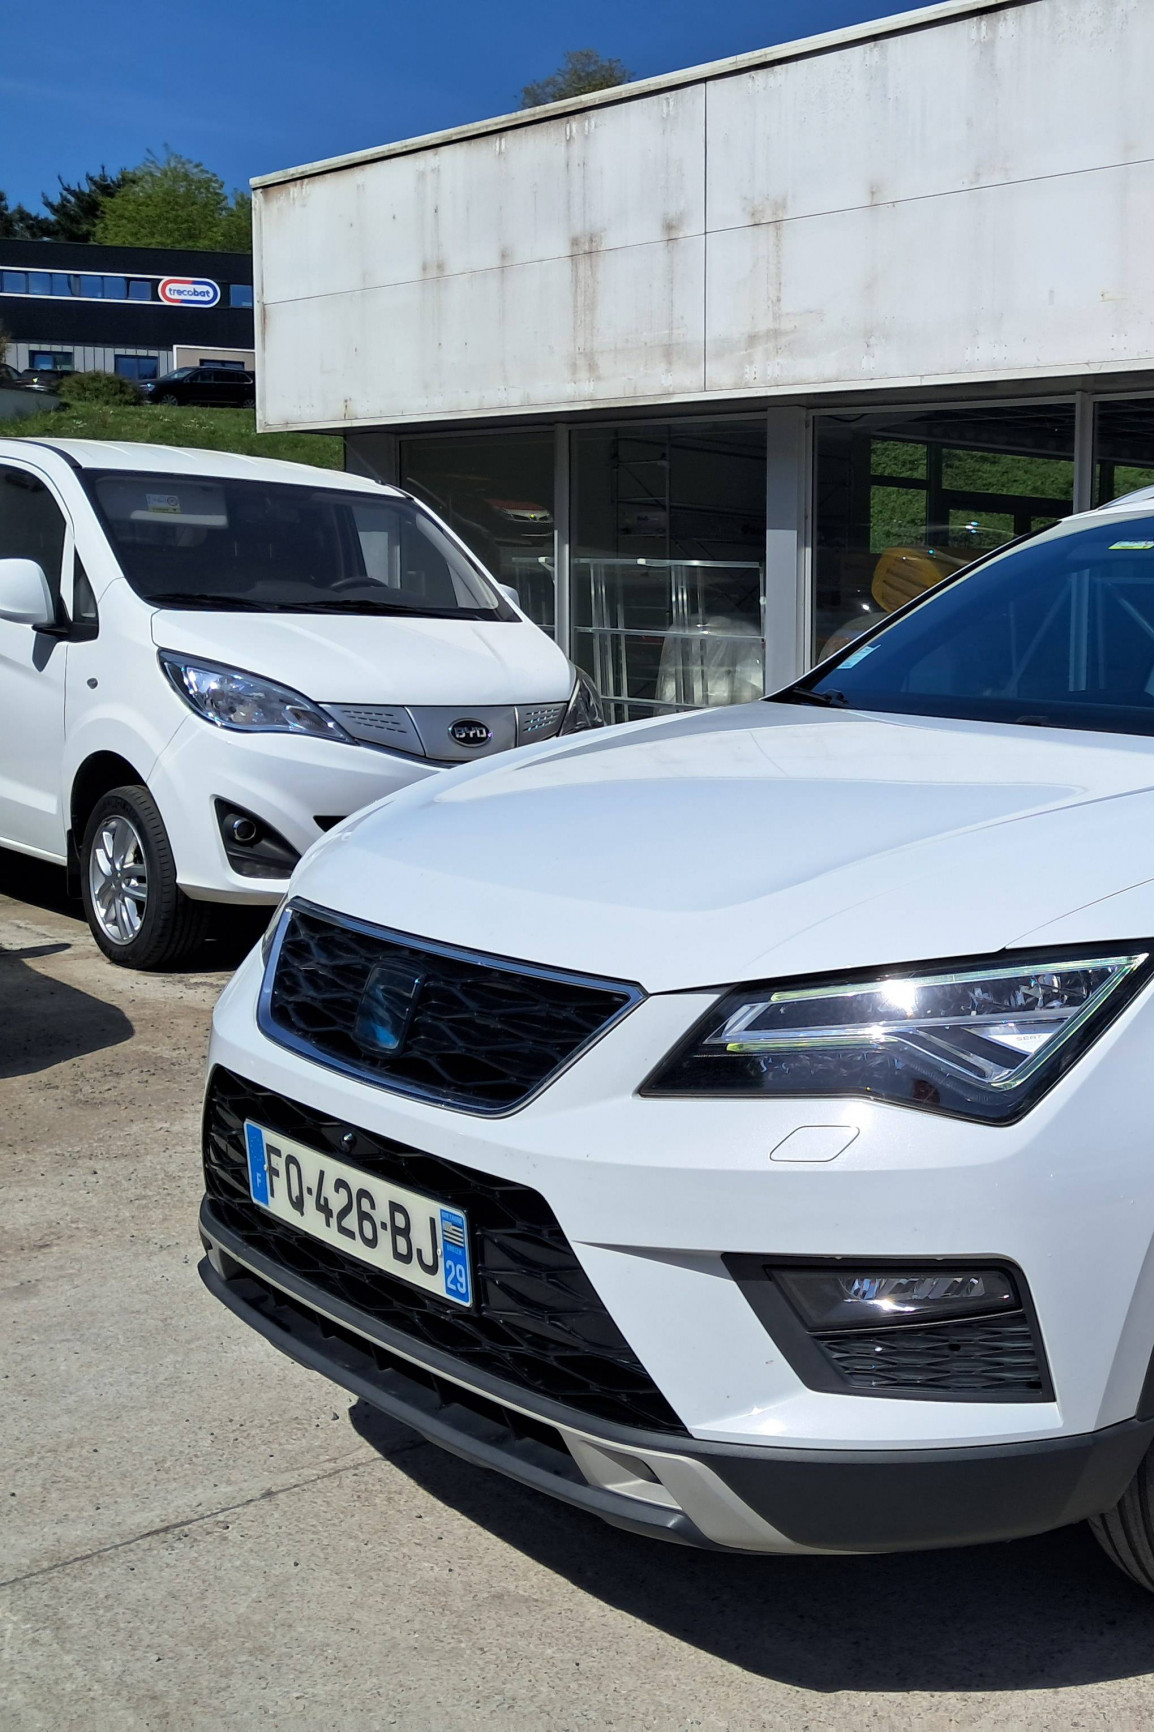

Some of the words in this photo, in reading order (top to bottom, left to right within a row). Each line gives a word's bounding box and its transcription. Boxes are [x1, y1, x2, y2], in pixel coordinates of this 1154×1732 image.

[168, 287, 211, 298] trecobat
[454, 727, 487, 738] BYD
[256, 1172, 262, 1187] F
[266, 1143, 440, 1277] FQ-426-BJ
[446, 1259, 467, 1294] 29
